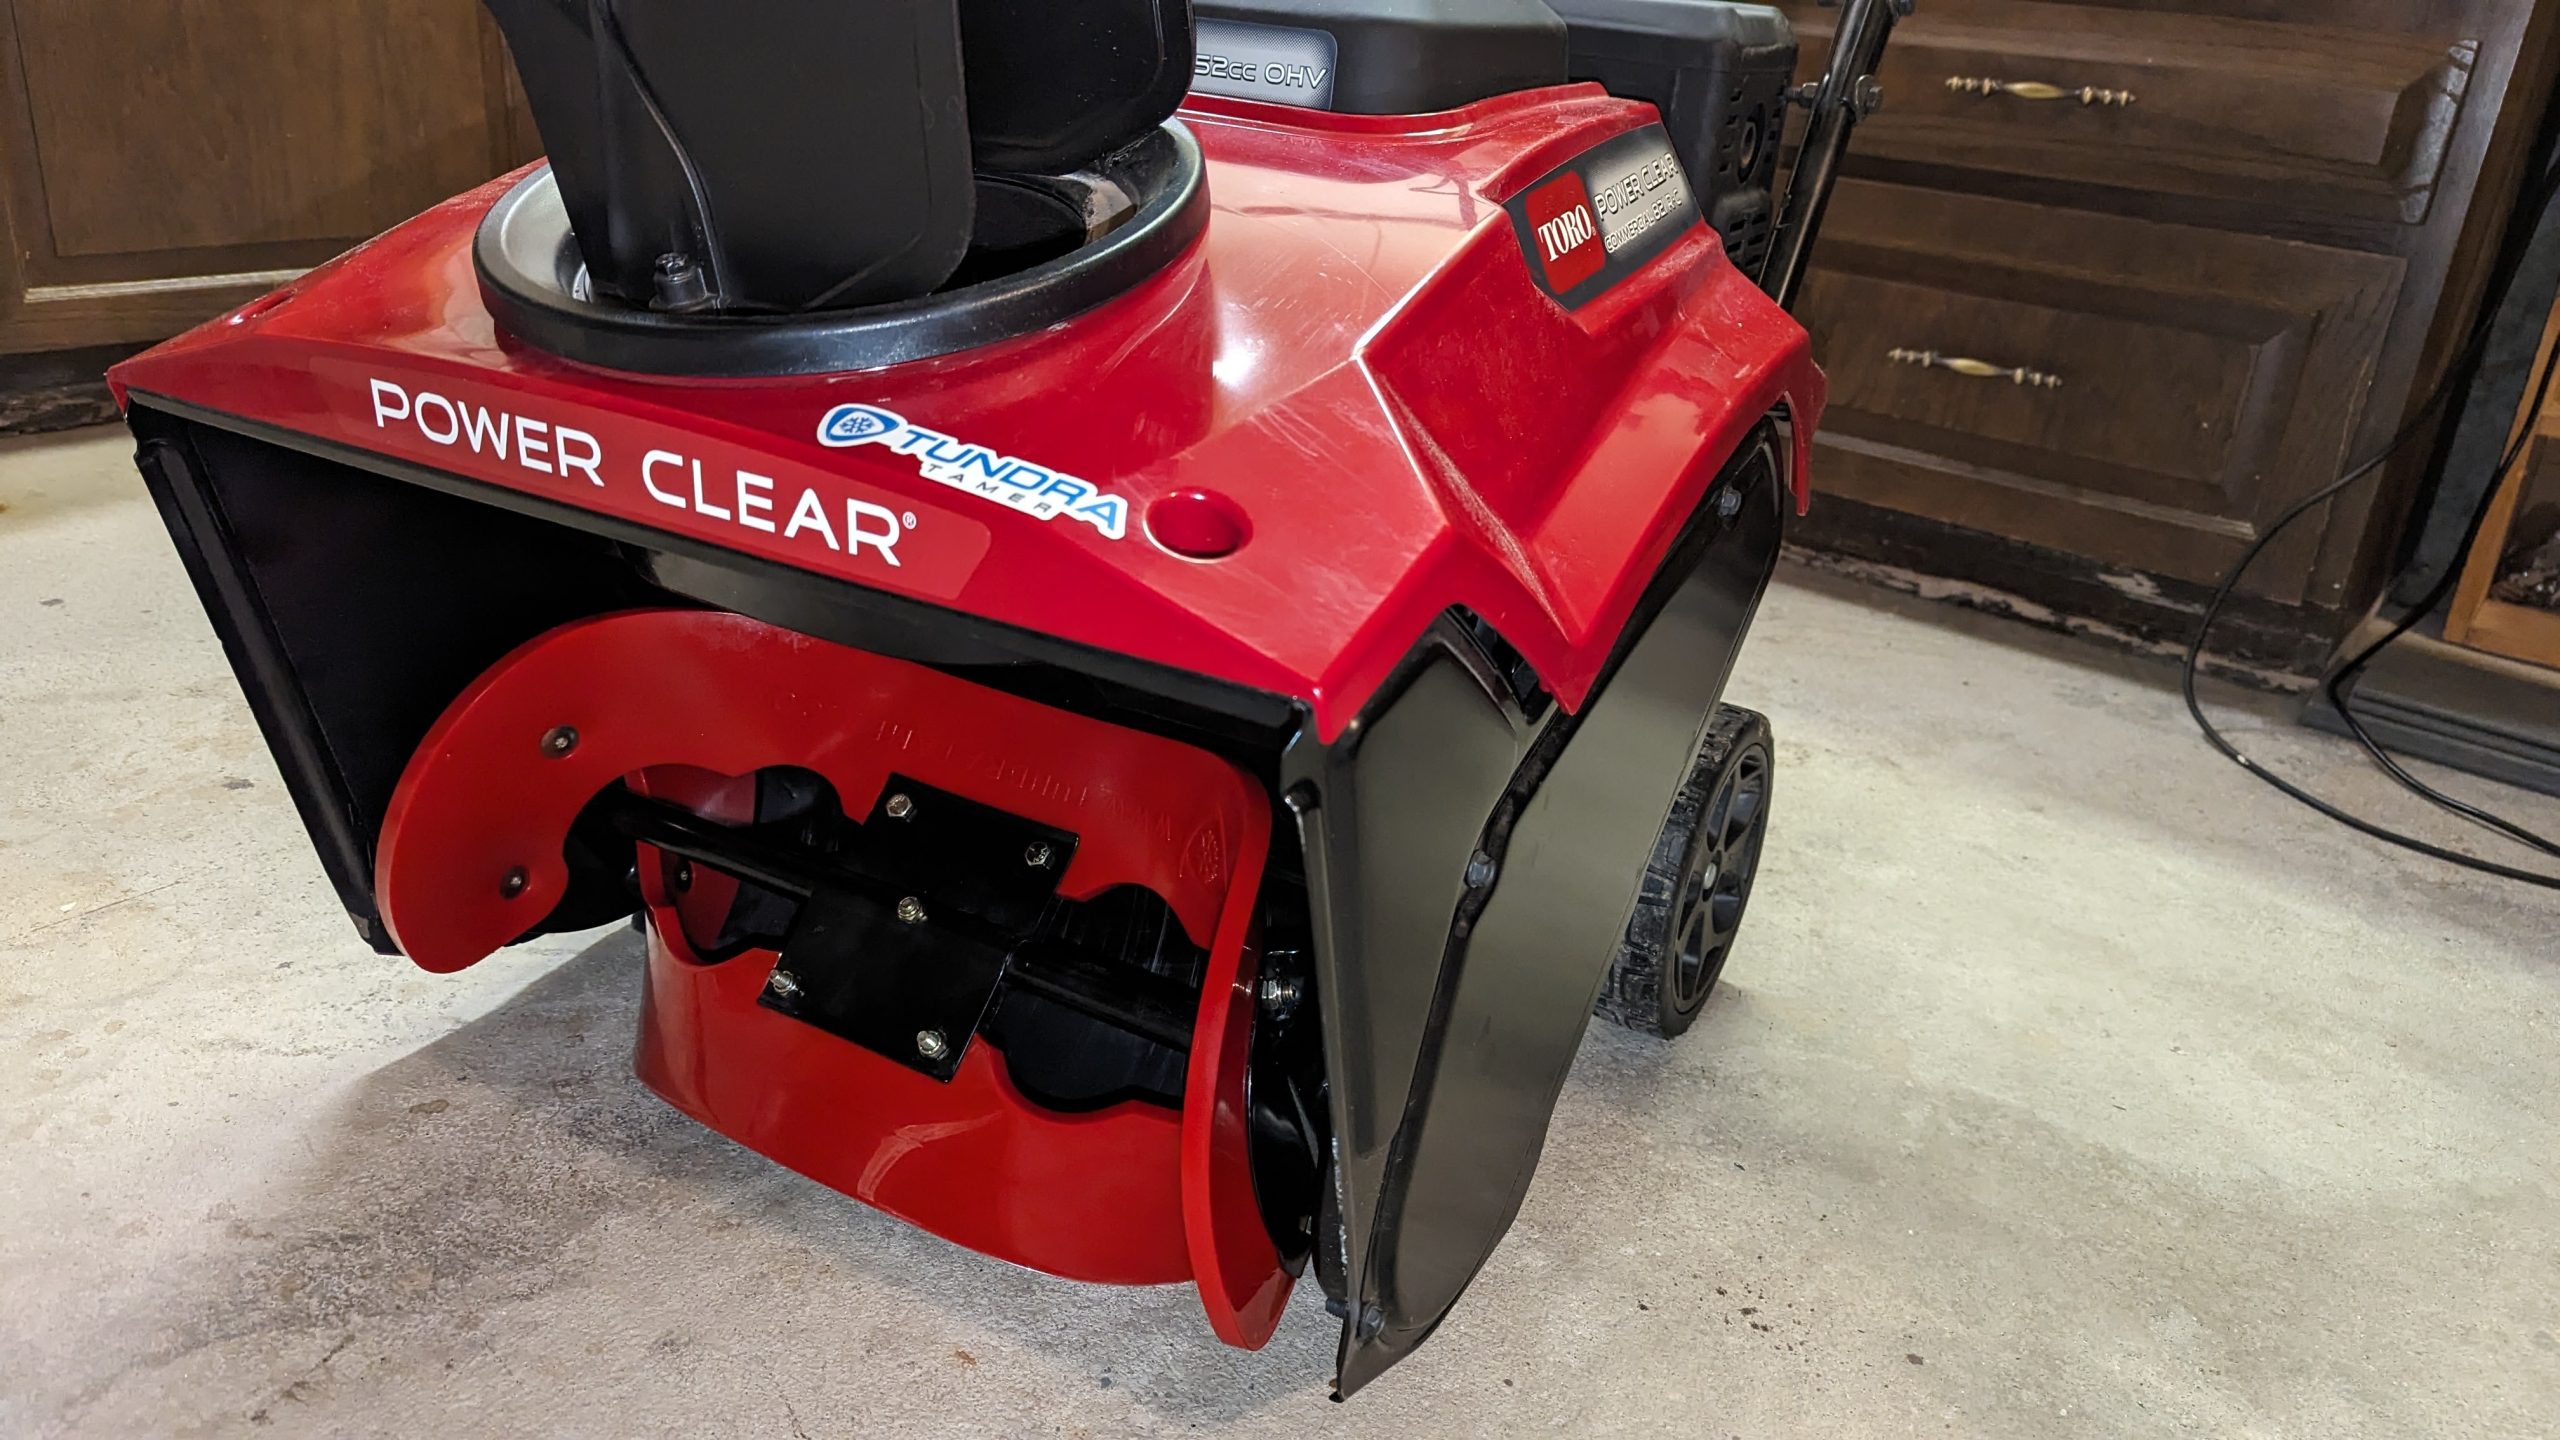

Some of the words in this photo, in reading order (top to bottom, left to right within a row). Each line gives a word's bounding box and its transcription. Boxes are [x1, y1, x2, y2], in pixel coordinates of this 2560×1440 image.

[1264, 62, 1327, 89] OHV
[1594, 173, 1643, 222] POWER
[1641, 152, 1679, 193] CLEAR
[1537, 204, 1594, 262] TORO
[1604, 209, 1656, 254] COMMERCIAL
[370, 378, 604, 487] POWER
[900, 428, 1120, 531] TUNDRA
[926, 463, 1053, 513] TAMER
